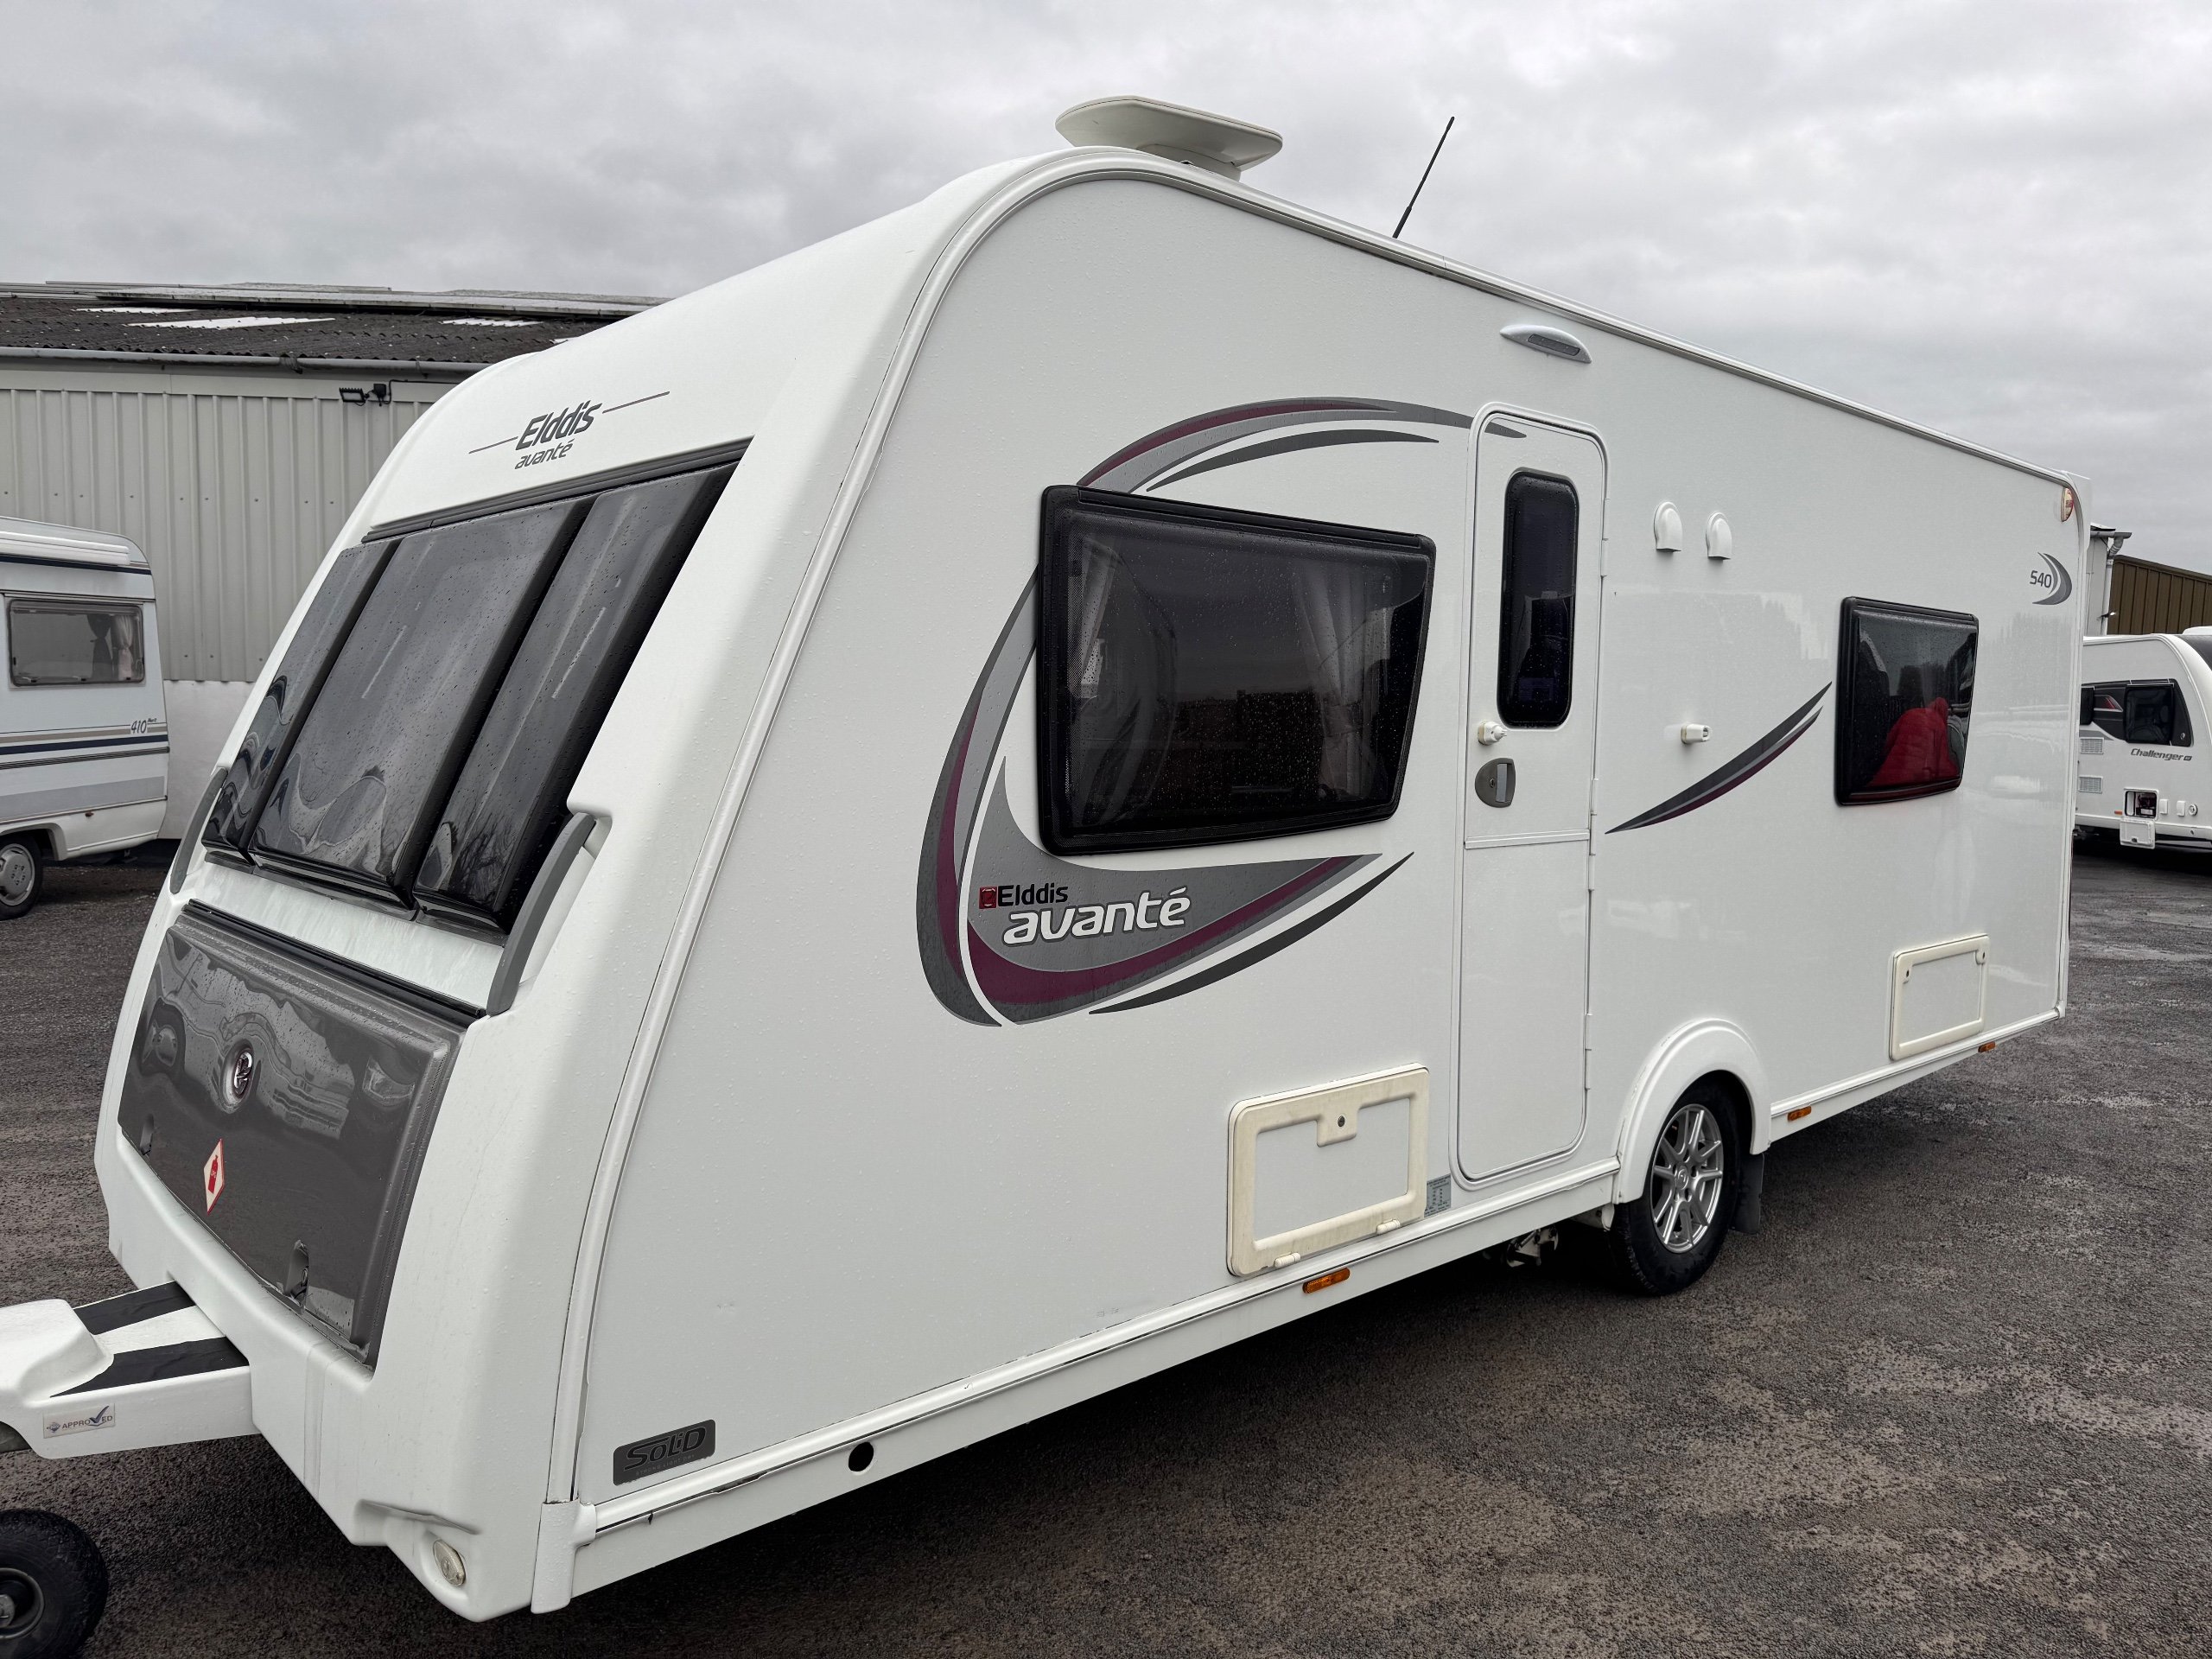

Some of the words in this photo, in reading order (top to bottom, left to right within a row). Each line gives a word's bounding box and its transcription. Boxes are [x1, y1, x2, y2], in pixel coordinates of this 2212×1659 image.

[515, 400, 603, 451] Elddis
[514, 438, 575, 469] avanté
[2029, 569, 2052, 588] 540
[130, 720, 147, 734] 410
[2130, 748, 2184, 761] Challenger
[997, 883, 1069, 906] Elddis
[1002, 886, 1191, 945] avanté
